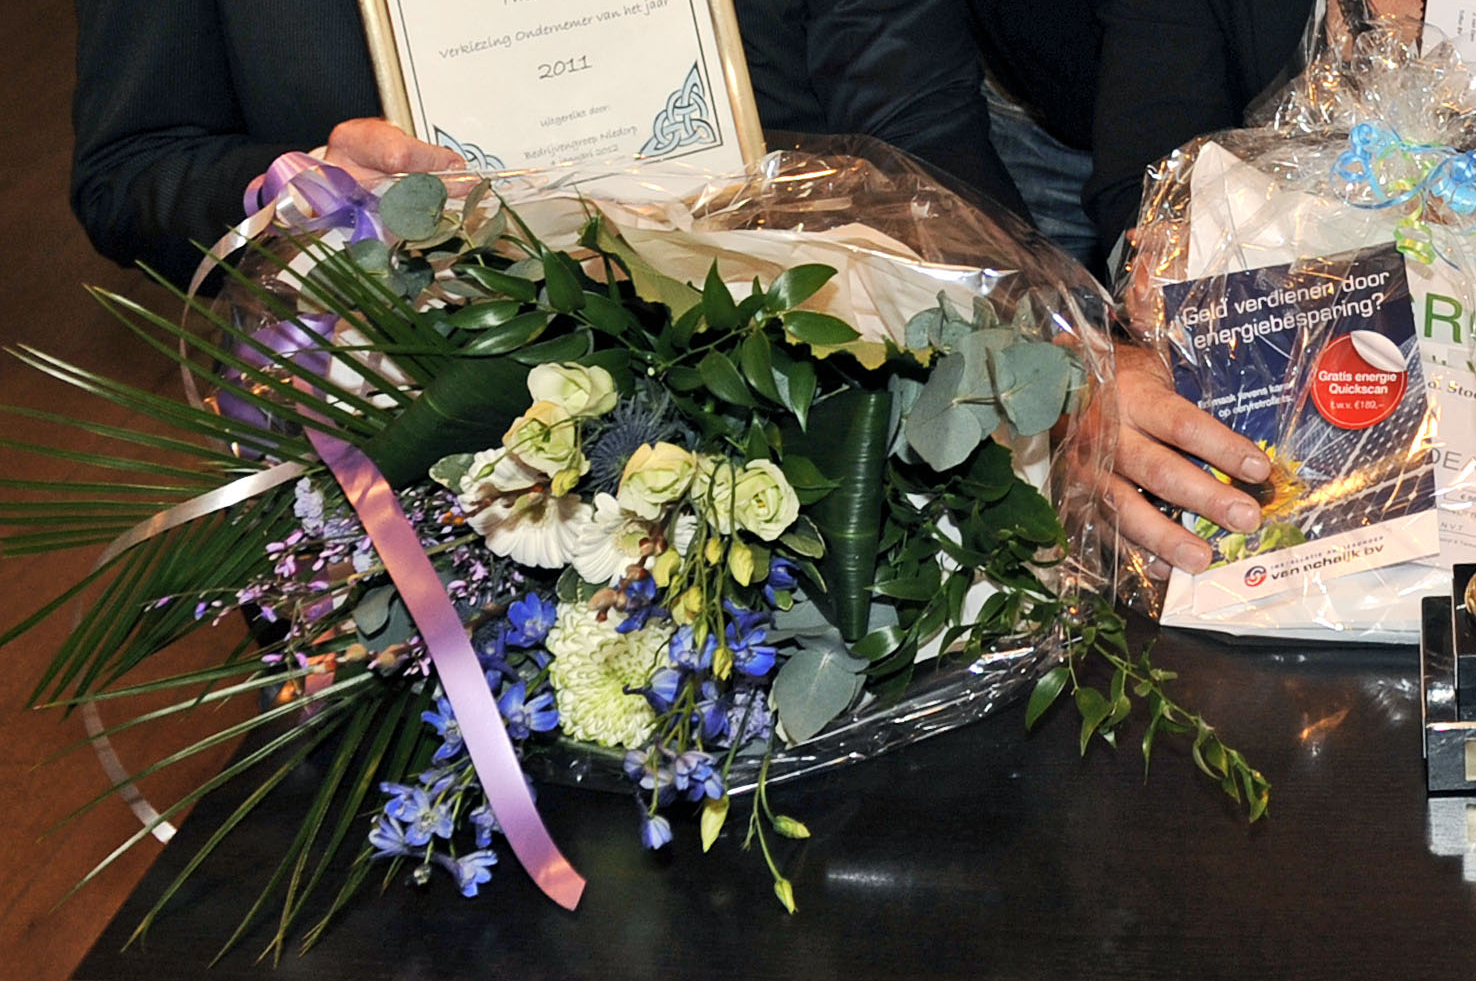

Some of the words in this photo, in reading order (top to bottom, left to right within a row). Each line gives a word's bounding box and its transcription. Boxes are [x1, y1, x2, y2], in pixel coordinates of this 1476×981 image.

[438, 32, 512, 60] Verkiezing
[515, 15, 593, 42] Ondernemer
[596, 9, 621, 23] van
[623, 3, 643, 17] het
[537, 55, 593, 80] 2011
[1182, 299, 1228, 325] Geld
[1234, 283, 1336, 316] verdienen
[1342, 271, 1390, 293] door
[1193, 292, 1386, 349] energiebesparing?
[1318, 370, 1353, 382] Gratis
[1354, 372, 1397, 385] energie
[1328, 383, 1389, 395] Quickscan
